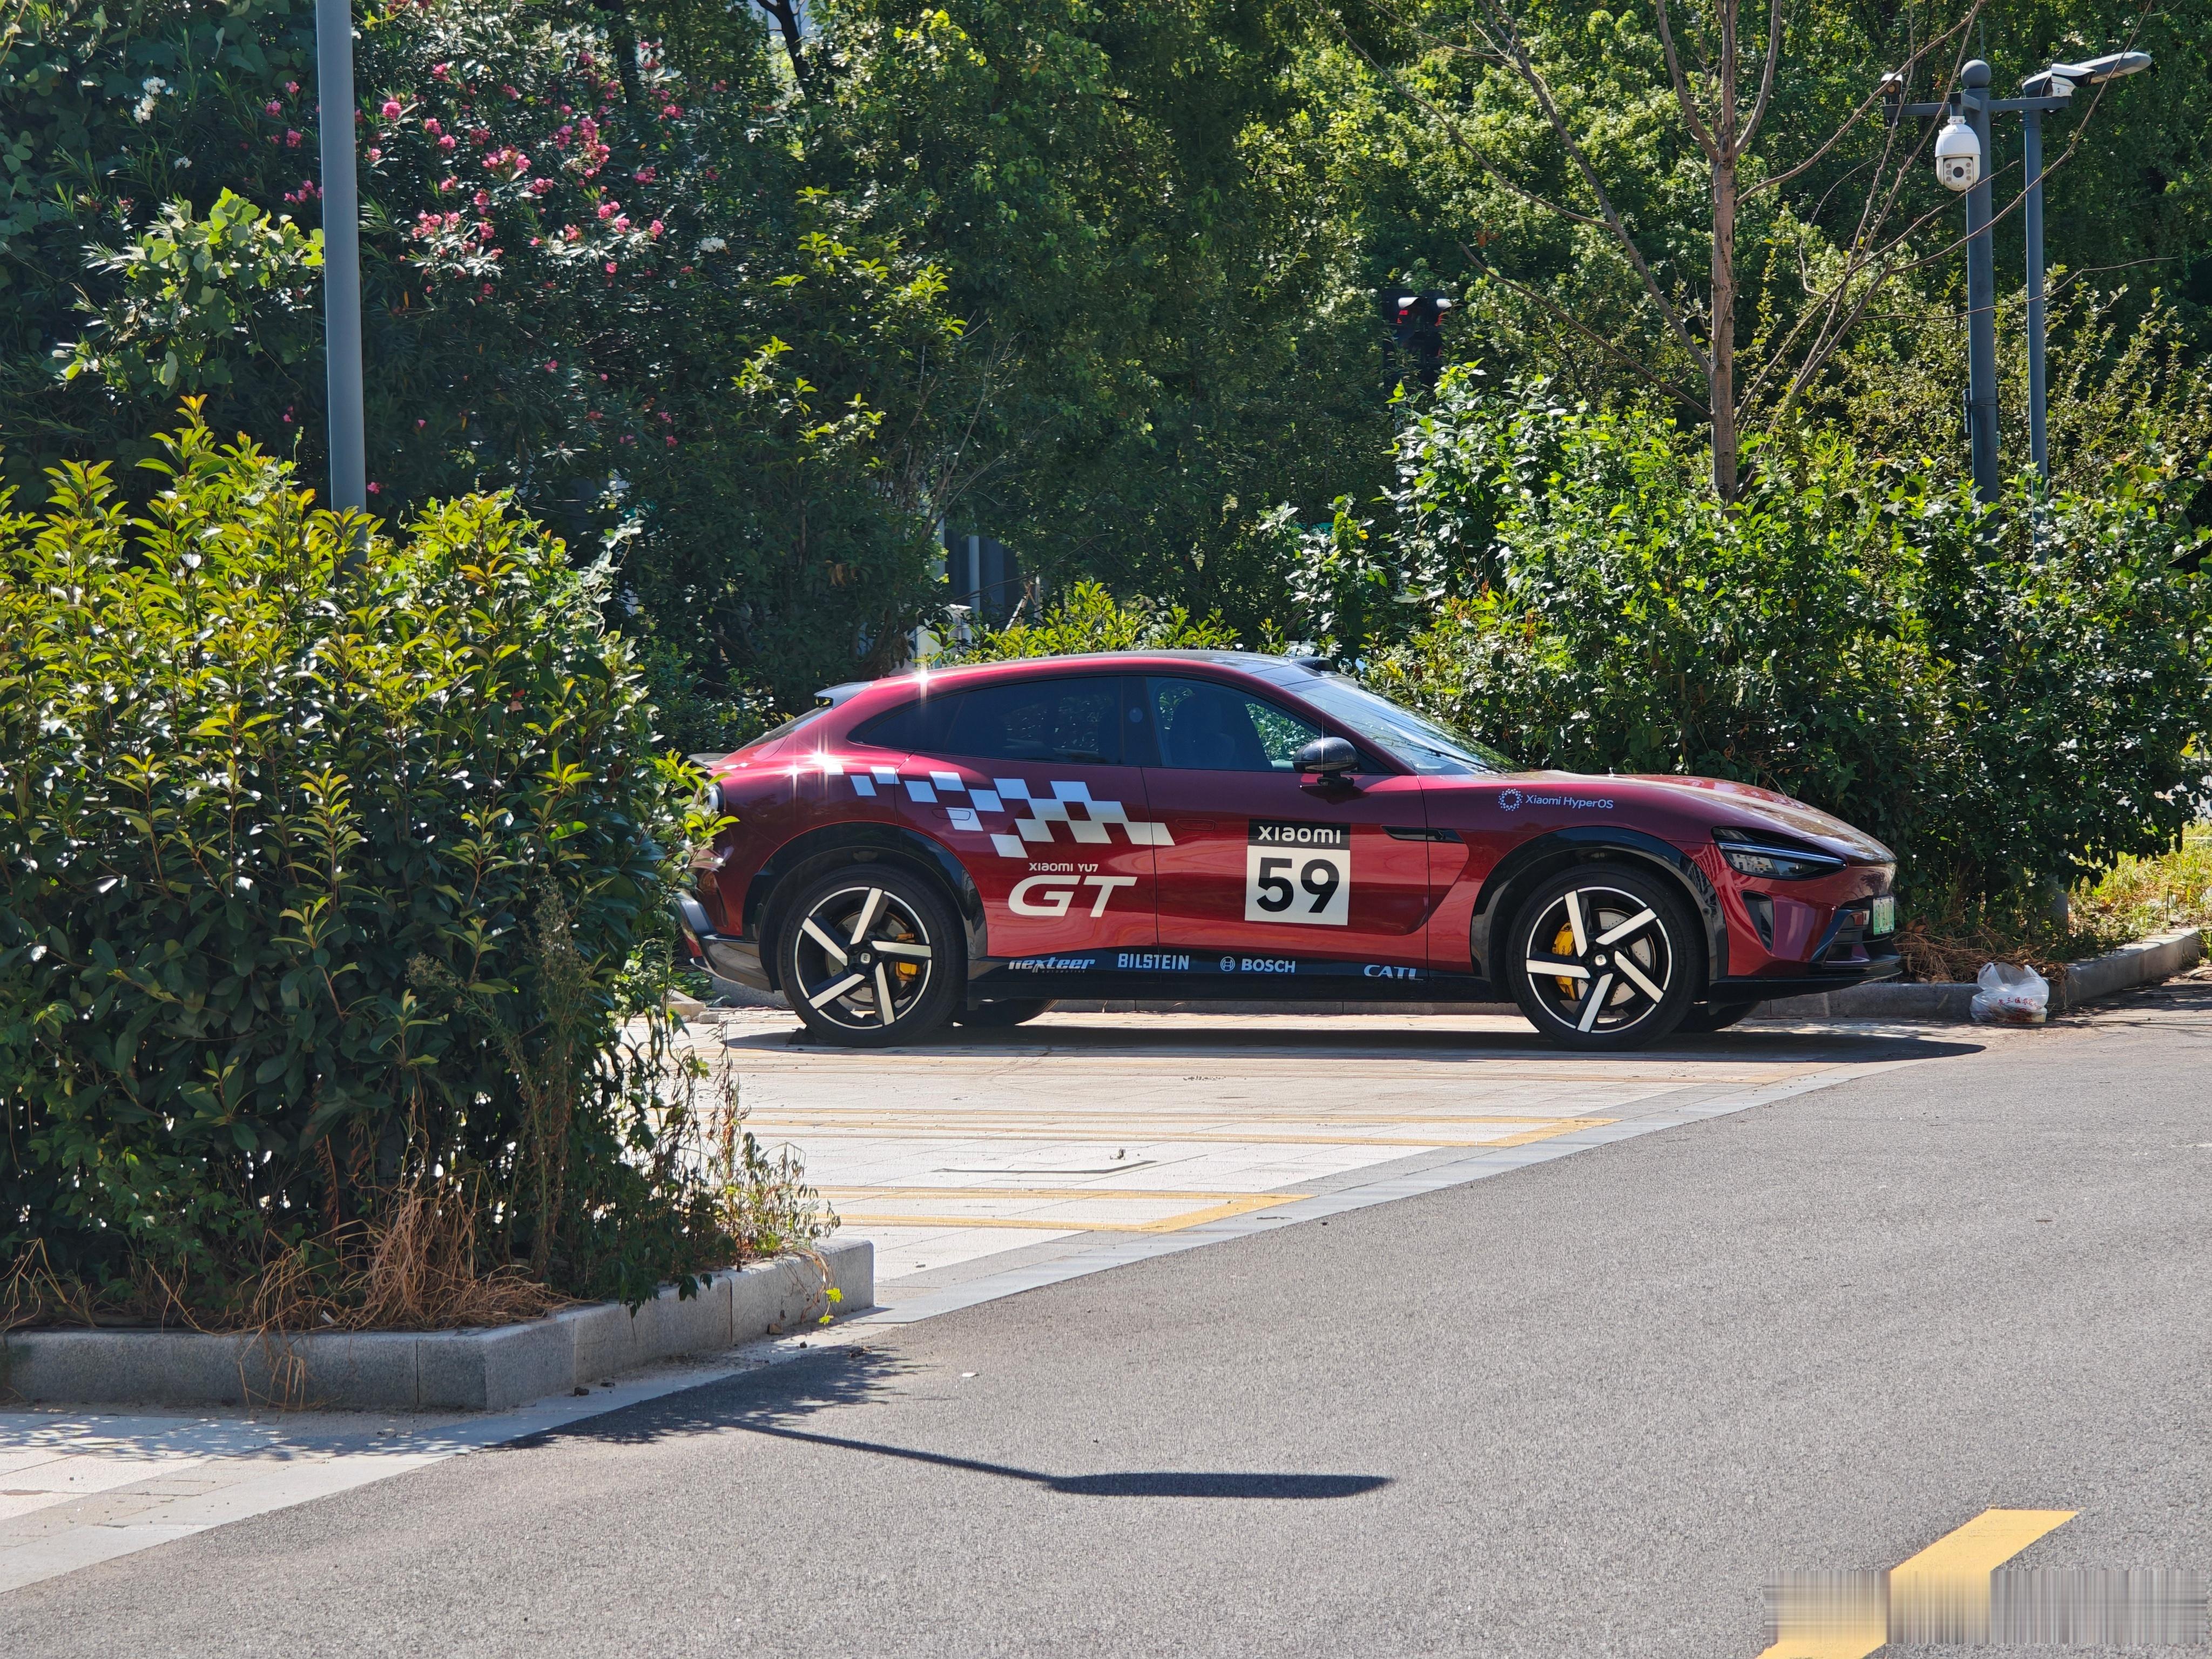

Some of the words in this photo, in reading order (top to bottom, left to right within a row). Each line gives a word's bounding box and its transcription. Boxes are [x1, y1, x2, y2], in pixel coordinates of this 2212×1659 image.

[1526, 795, 1561, 805] Xiaomi
[1563, 797, 1614, 809] HyperOS
[1258, 826, 1340, 844] xiaomi
[1077, 863, 1098, 872] YU7
[1257, 857, 1339, 913] 59
[1008, 875, 1137, 917] GT
[1008, 957, 1096, 973] nexteer
[1117, 953, 1189, 970] BILSTEIN
[1241, 958, 1296, 973] BOSCH
[1364, 965, 1424, 981] CATL
